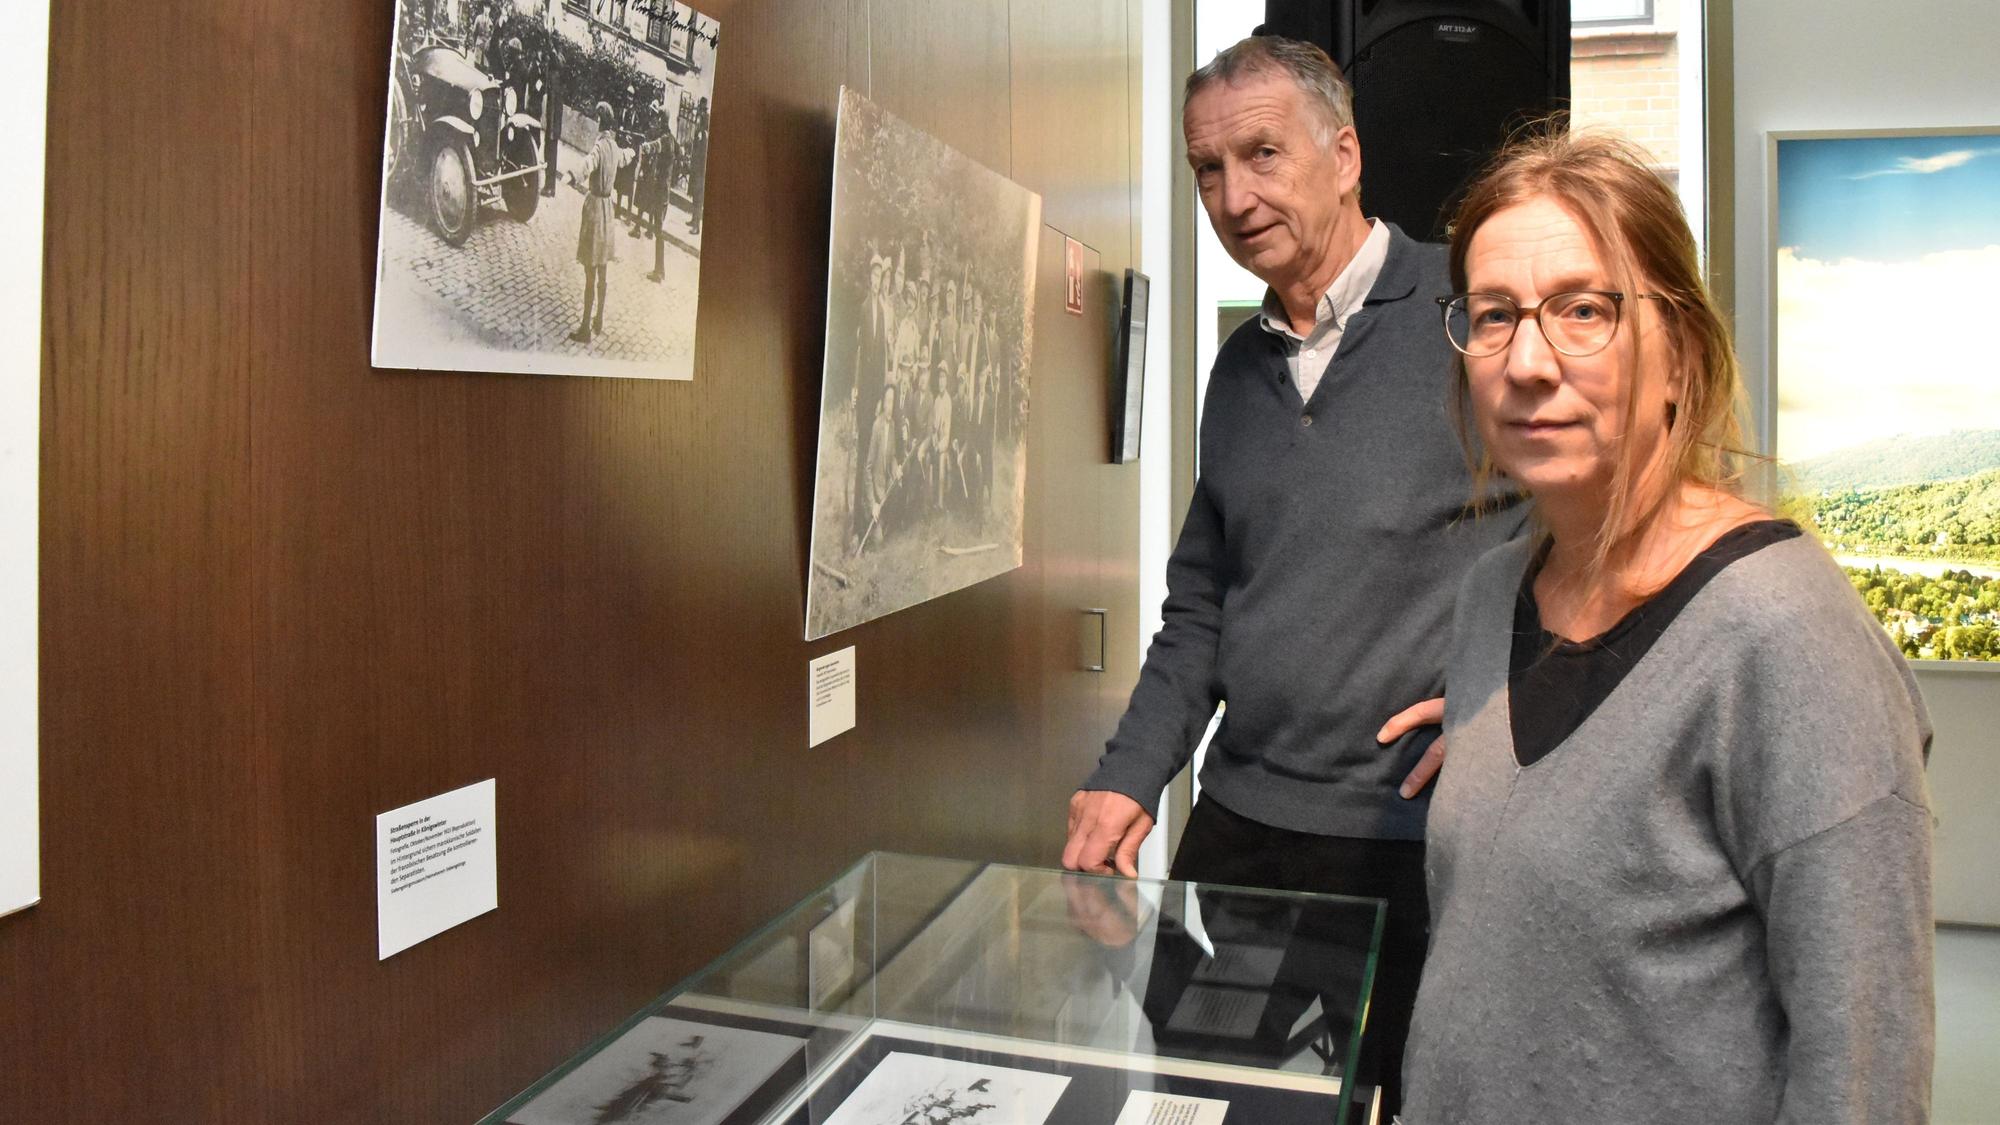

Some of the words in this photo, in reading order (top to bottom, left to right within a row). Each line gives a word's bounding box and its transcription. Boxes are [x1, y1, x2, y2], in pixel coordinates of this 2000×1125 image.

[1438, 24, 1453, 32] ART
[390, 820, 418, 834] Straßensperre
[390, 829, 415, 843] Hauptstraße
[421, 820, 446, 832] Königswinter
[397, 850, 421, 861] Hintergrund
[426, 849, 446, 861] Besatzung
